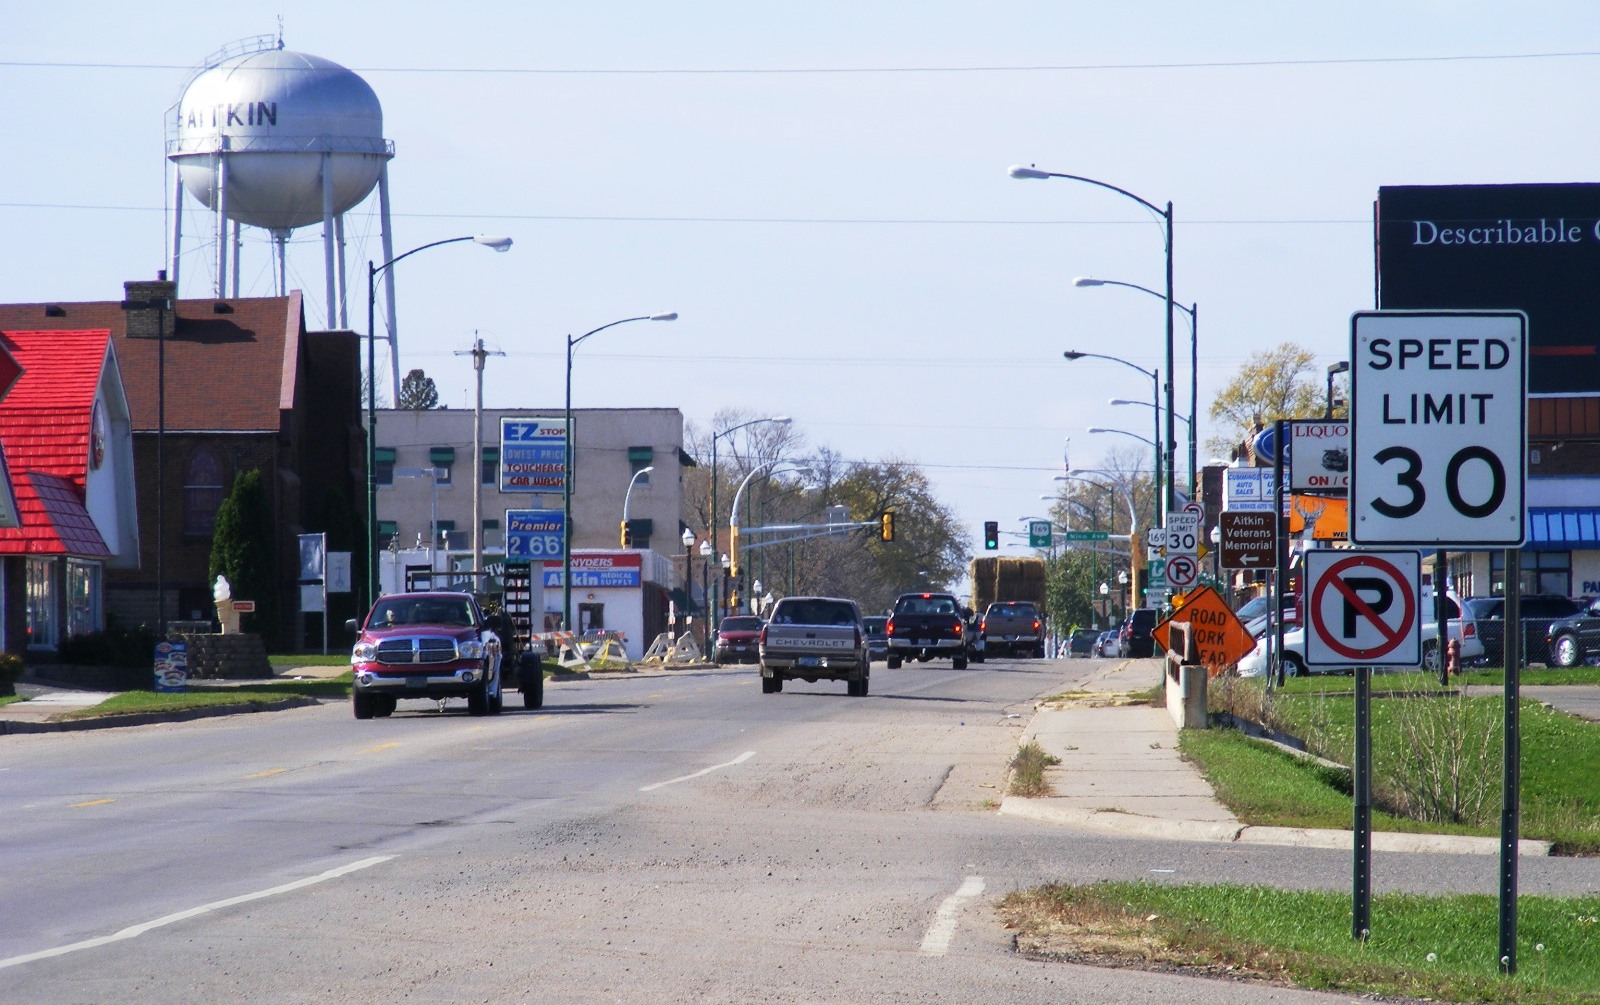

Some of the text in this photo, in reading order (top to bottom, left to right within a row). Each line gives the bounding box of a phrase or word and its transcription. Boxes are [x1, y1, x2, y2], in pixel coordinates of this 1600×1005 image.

[187, 101, 278, 129] AITKIN
[1413, 218, 1582, 245] Describable
[1368, 338, 1511, 371] SPEED
[1383, 393, 1494, 425] LIMIT
[503, 423, 566, 441] EZ STOP
[1295, 425, 1348, 439] LIQUO
[509, 477, 564, 486] CAR WASH
[1308, 476, 1329, 486] ON
[1370, 446, 1507, 519] 30
[1235, 488, 1254, 496] SALES
[511, 520, 562, 531] Premier
[1169, 516, 1197, 524] SPEED
[1232, 516, 1264, 526] Aitkin
[1171, 525, 1193, 533] LIMIT
[1226, 528, 1271, 538] Veterans
[1150, 532, 1166, 542] 169
[1168, 533, 1196, 550] 30
[1225, 540, 1273, 551] Memorial
[570, 557, 614, 568] NYDERS
[547, 572, 599, 587] Aikin
[600, 578, 633, 586] SUPPLY
[1583, 581, 1600, 594] PA
[1190, 608, 1227, 627] ROAD
[775, 639, 847, 647] CHEVROLET
[1194, 628, 1225, 646] ORK
[1200, 649, 1226, 665] EAD
